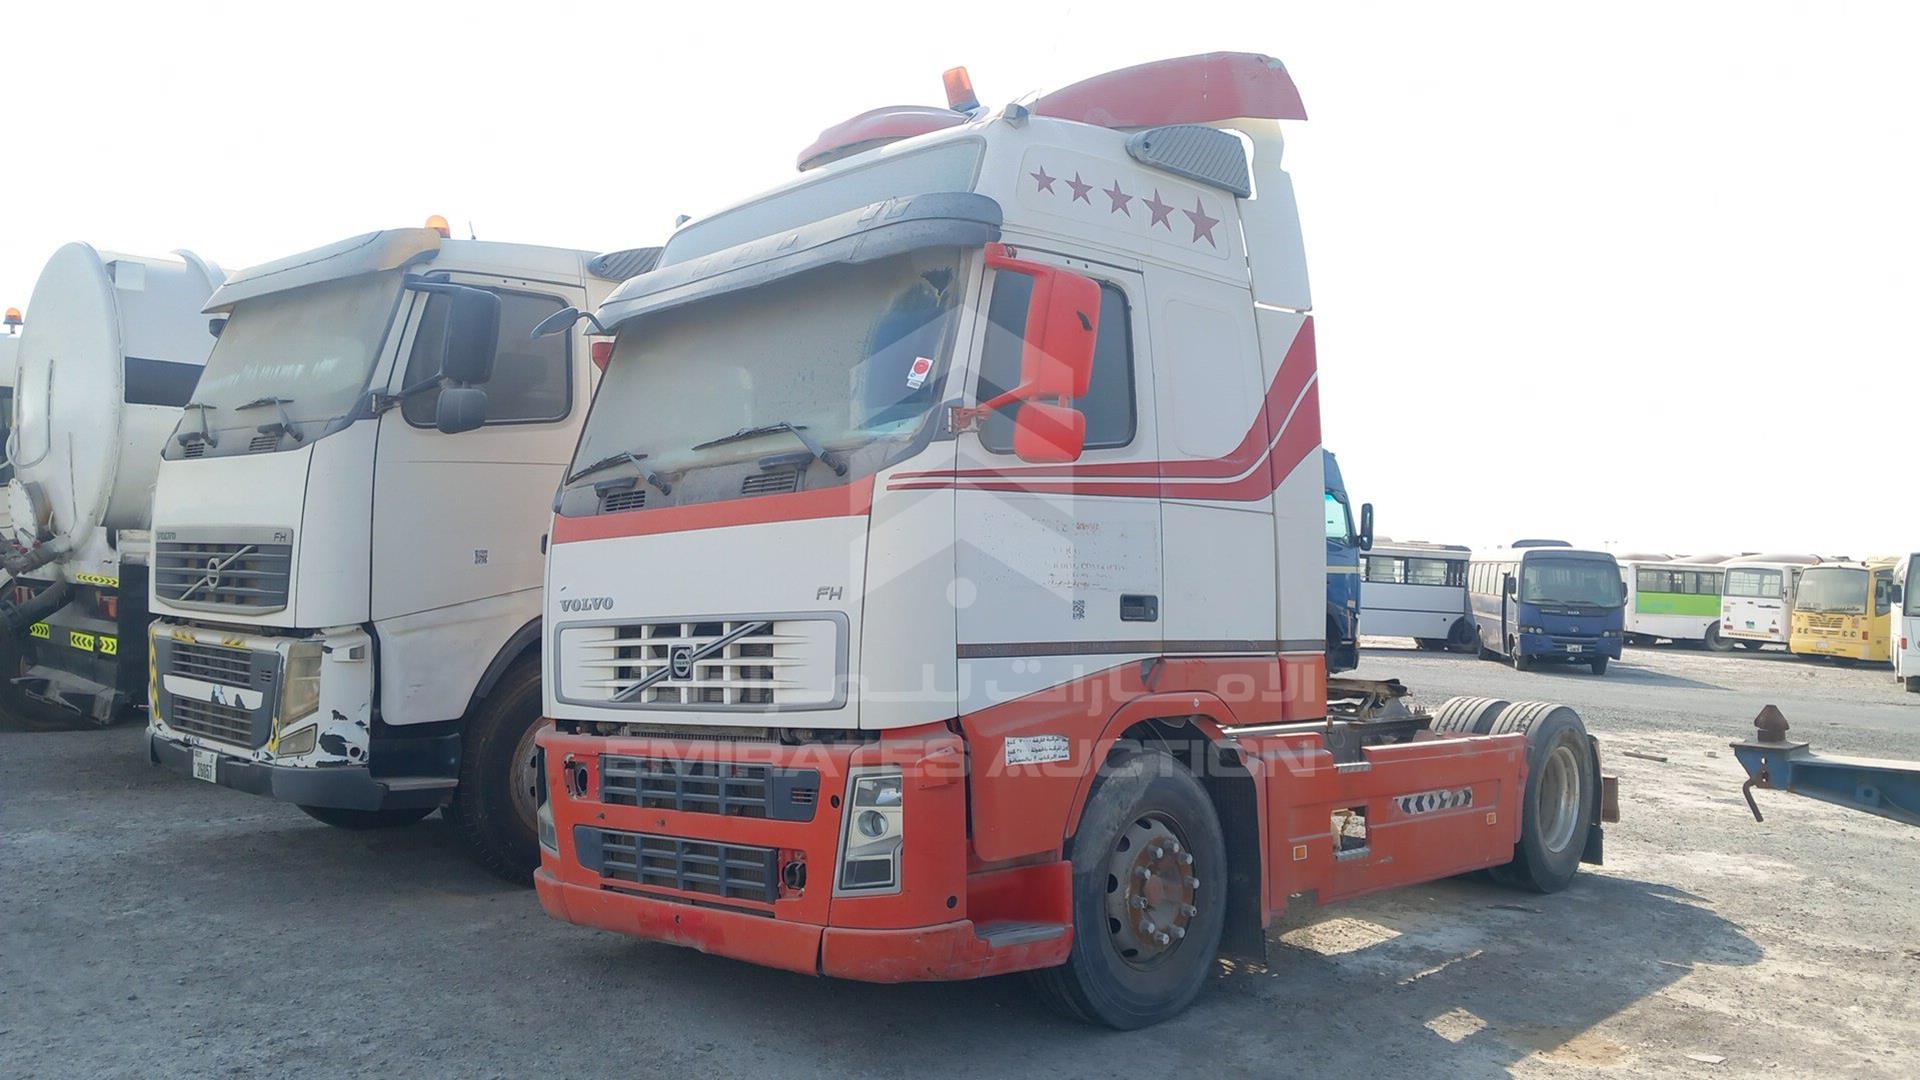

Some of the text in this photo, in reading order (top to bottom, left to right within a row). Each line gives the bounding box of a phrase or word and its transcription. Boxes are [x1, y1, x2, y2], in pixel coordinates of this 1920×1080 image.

[273, 532, 287, 543] FH
[815, 585, 844, 601] FH
[559, 596, 614, 613] VOLVO
